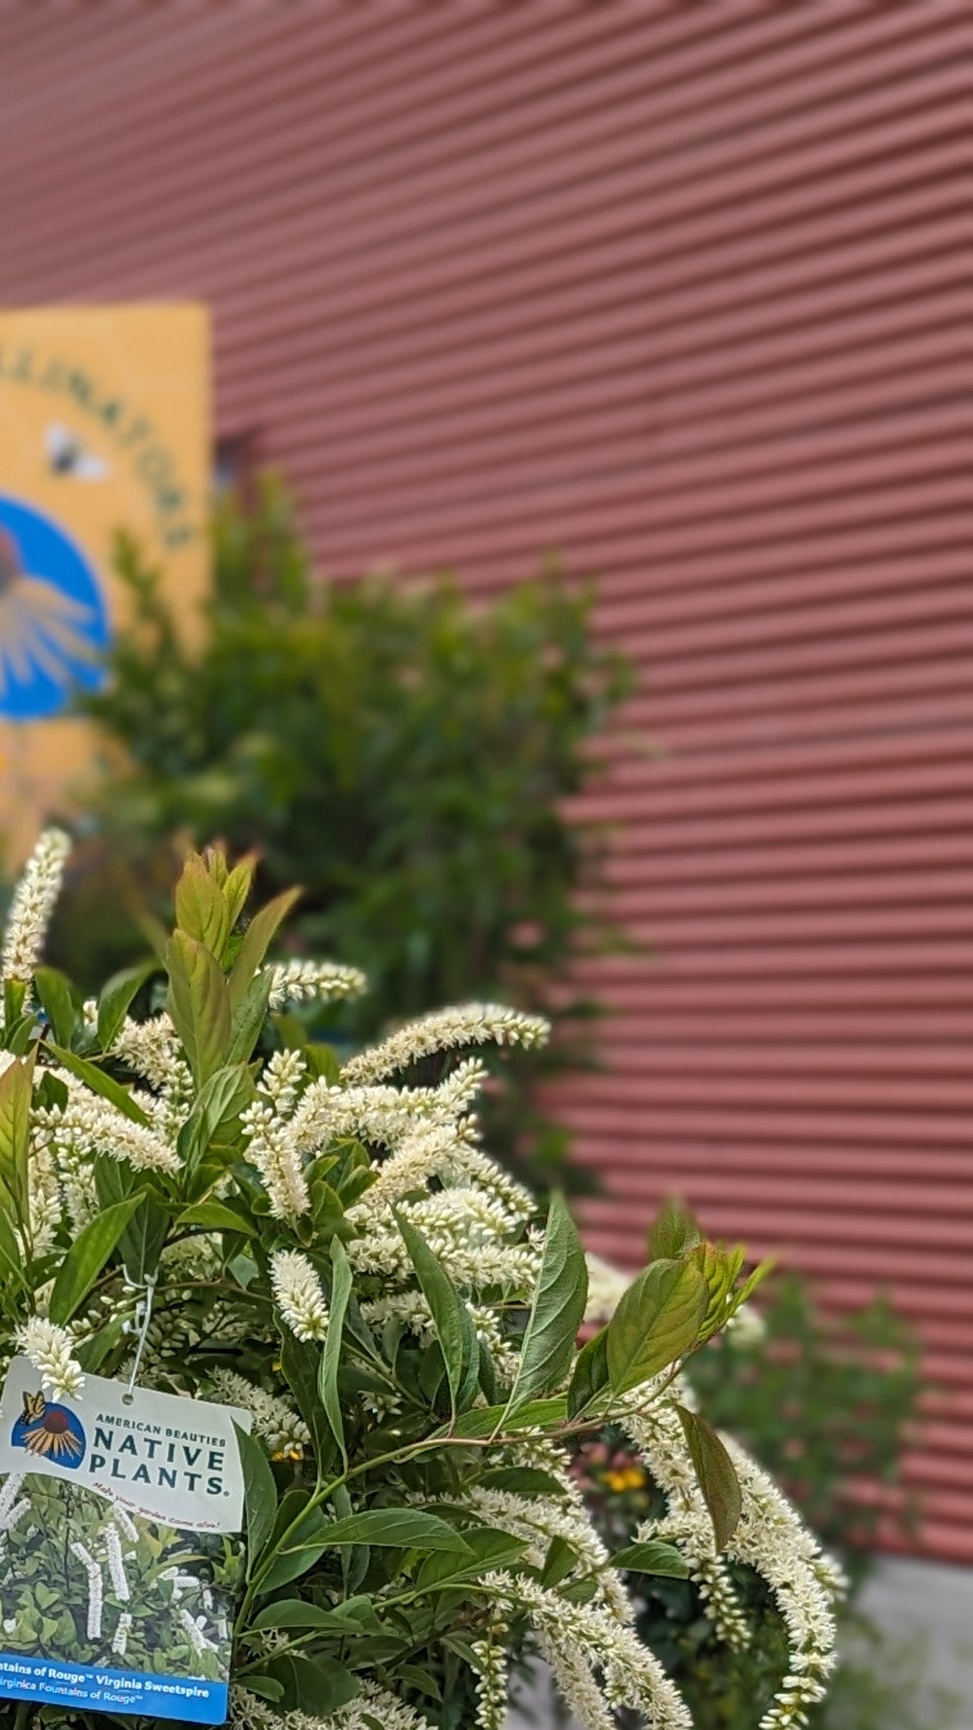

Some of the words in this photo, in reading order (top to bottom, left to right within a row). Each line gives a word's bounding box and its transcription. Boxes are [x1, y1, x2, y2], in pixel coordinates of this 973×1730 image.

[96, 1413, 162, 1435] AMERICAN
[165, 1428, 226, 1447] BEAUTIES
[93, 1427, 225, 1472] NATIVE
[33, 1664, 46, 1677] of
[95, 1674, 142, 1690] Virginia
[143, 1680, 210, 1699] Sweetspire
[38, 1682, 89, 1699] Fountains
[89, 1690, 102, 1700] of
